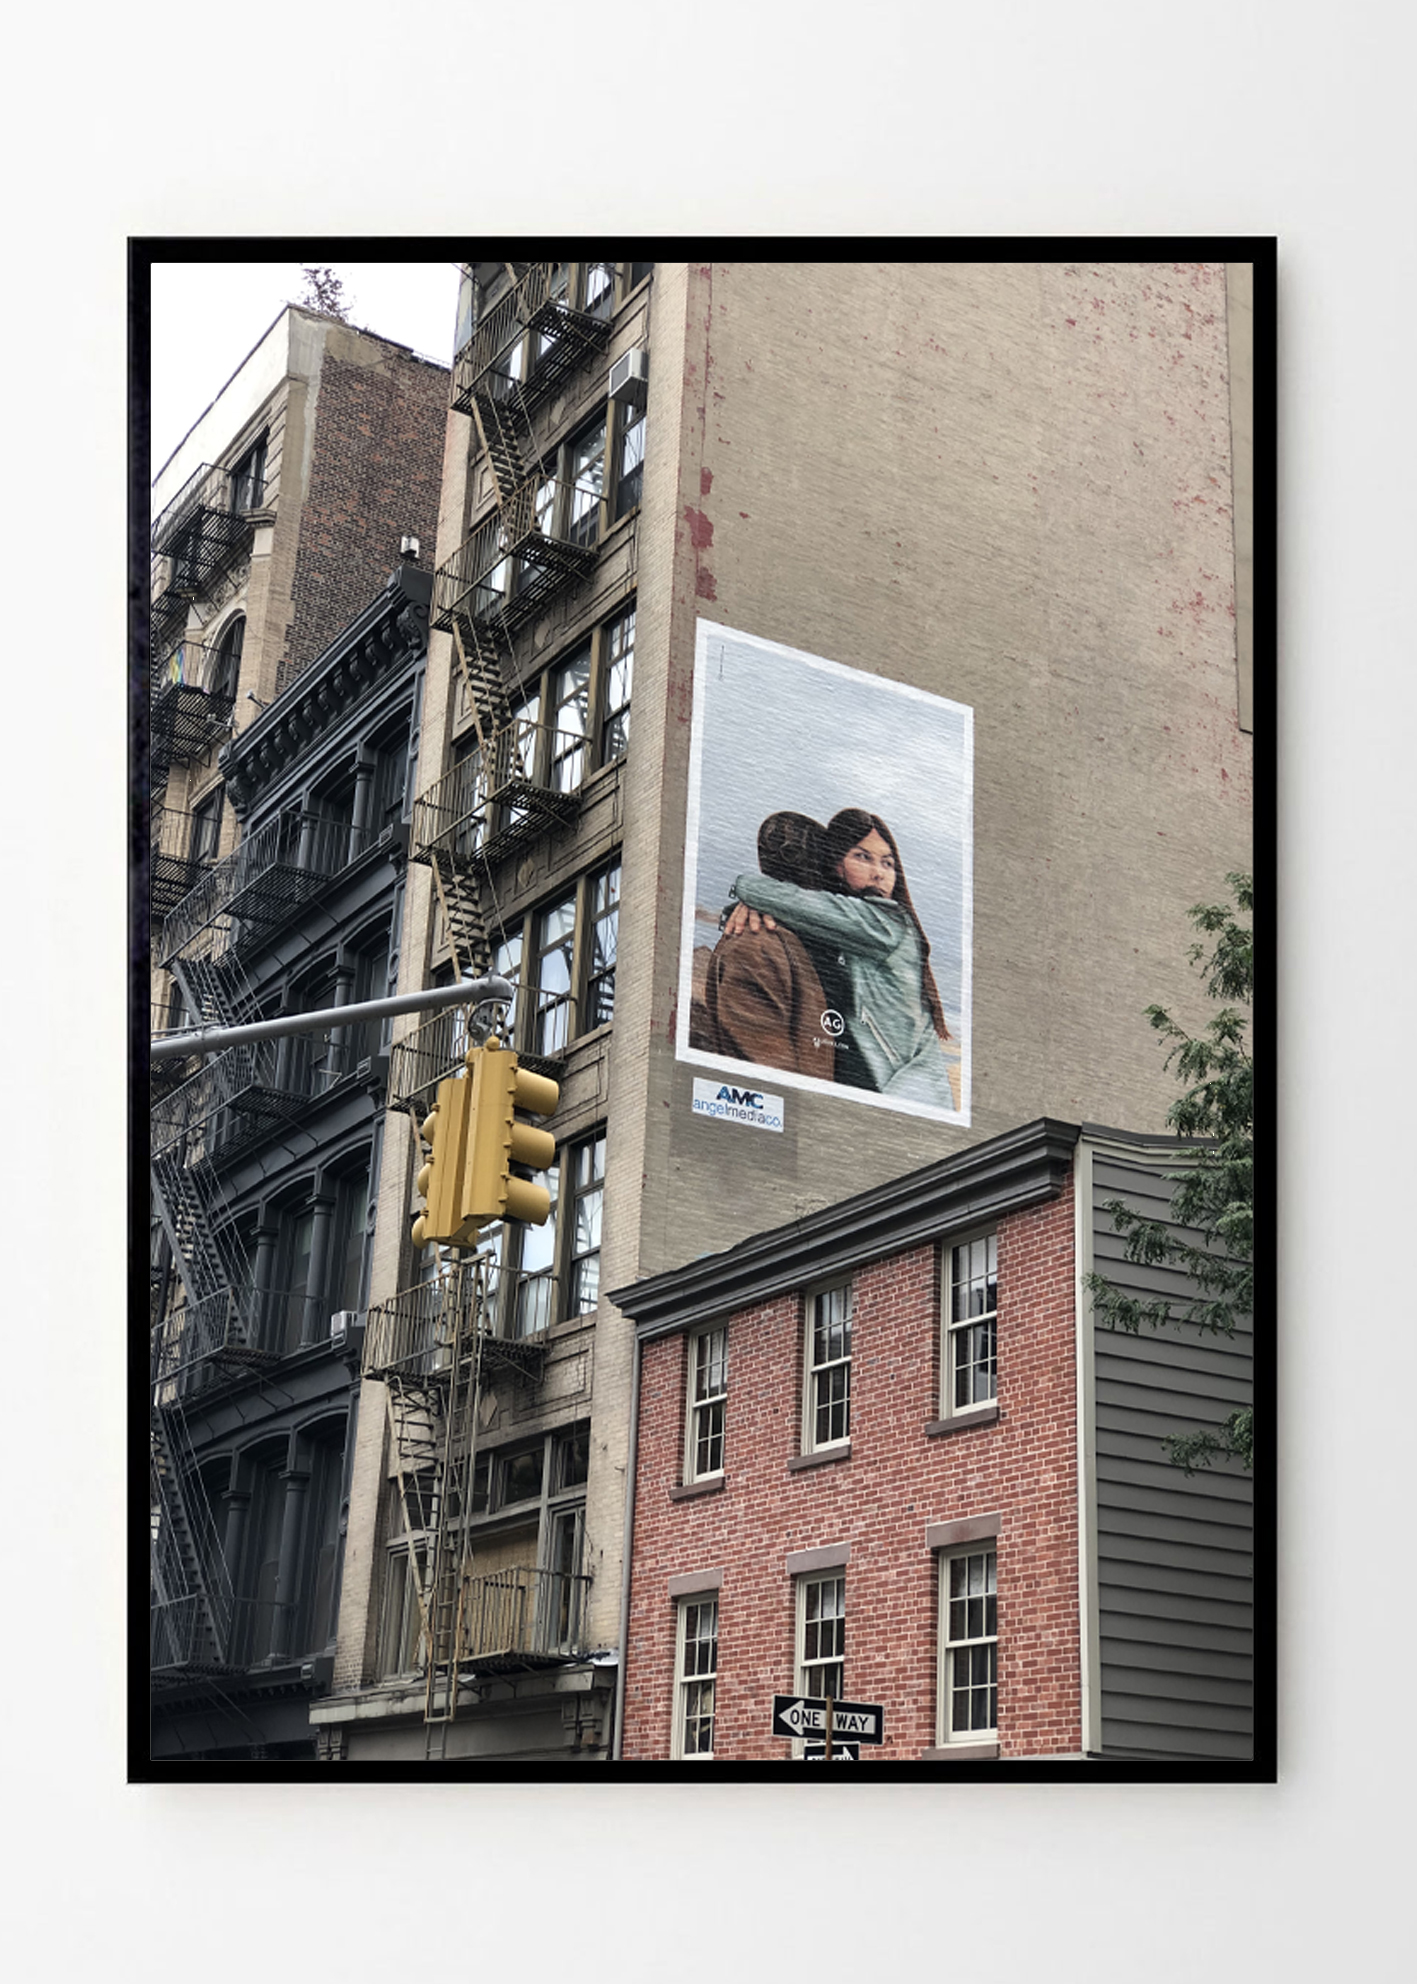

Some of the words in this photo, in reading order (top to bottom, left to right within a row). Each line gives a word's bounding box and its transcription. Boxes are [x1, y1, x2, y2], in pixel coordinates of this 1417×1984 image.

[824, 1016, 841, 1029] AG
[716, 1085, 764, 1109] AMC
[790, 1709, 821, 1727] ONE
[836, 1713, 869, 1732] WAY
